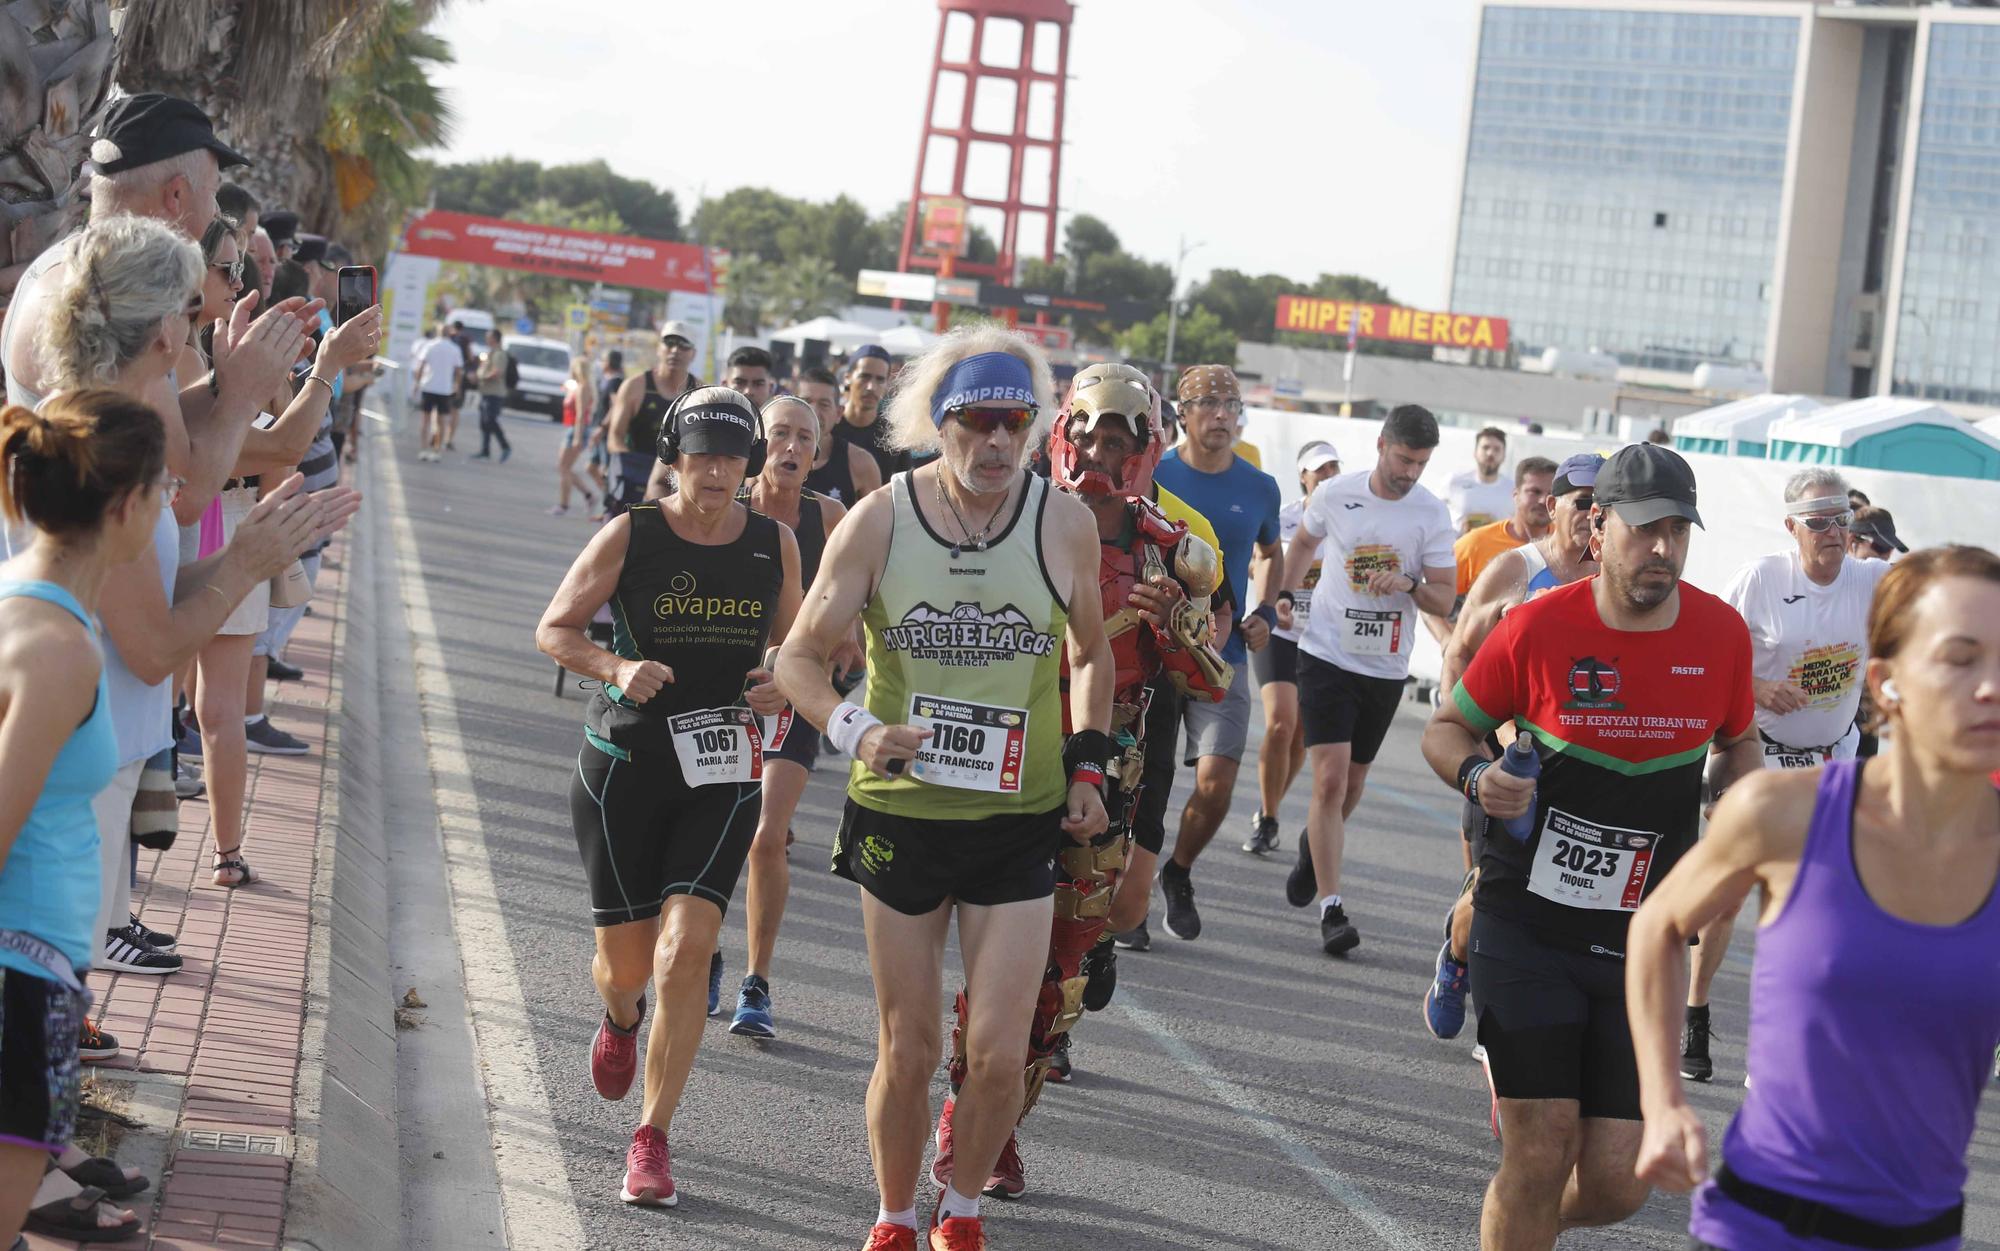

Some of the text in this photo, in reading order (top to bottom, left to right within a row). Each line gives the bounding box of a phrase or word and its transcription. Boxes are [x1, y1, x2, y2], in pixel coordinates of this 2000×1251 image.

[1288, 299, 1493, 347] HIPER MERCA
[943, 387, 1037, 411] COMPRESS
[701, 411, 751, 432] LURBEL
[659, 596, 762, 621] avapace
[653, 623, 759, 636] asociación valenciana de
[1354, 622, 1384, 637] 2141
[654, 636, 677, 644] ayuda
[881, 622, 1057, 657] MURCIELAGOS
[911, 649, 1014, 661] CLUB DE ATLETISMO
[938, 658, 990, 667] VALENCIA
[1671, 666, 1705, 675] FASTER
[1803, 659, 1832, 671] MEDIO
[1816, 675, 1837, 686] VILA
[1839, 671, 1850, 681] DE
[920, 701, 939, 709] MEDIA
[940, 703, 973, 714] MARATÓN
[677, 717, 694, 725] MEDIA
[701, 718, 725, 726] PATERNA
[944, 711, 973, 721] PATERNA
[1559, 714, 1708, 730] THE KENYAN URBAN WAY
[692, 728, 738, 754] 1067
[750, 734, 761, 750] BOX
[932, 722, 986, 755] 1160
[1598, 729, 1676, 740] RAQUEL LANDIN
[1009, 740, 1019, 758] BOX
[696, 755, 739, 767] MARIA JOSE
[914, 751, 994, 771] JOSE FRANCISCO
[1553, 822, 1602, 843] VILA DE PATERNA
[1554, 816, 1602, 837] MEDIA MARATÓN
[1552, 839, 1620, 877] 2023
[1634, 860, 1645, 876] BOX
[1560, 872, 1595, 889] MIQUEL
